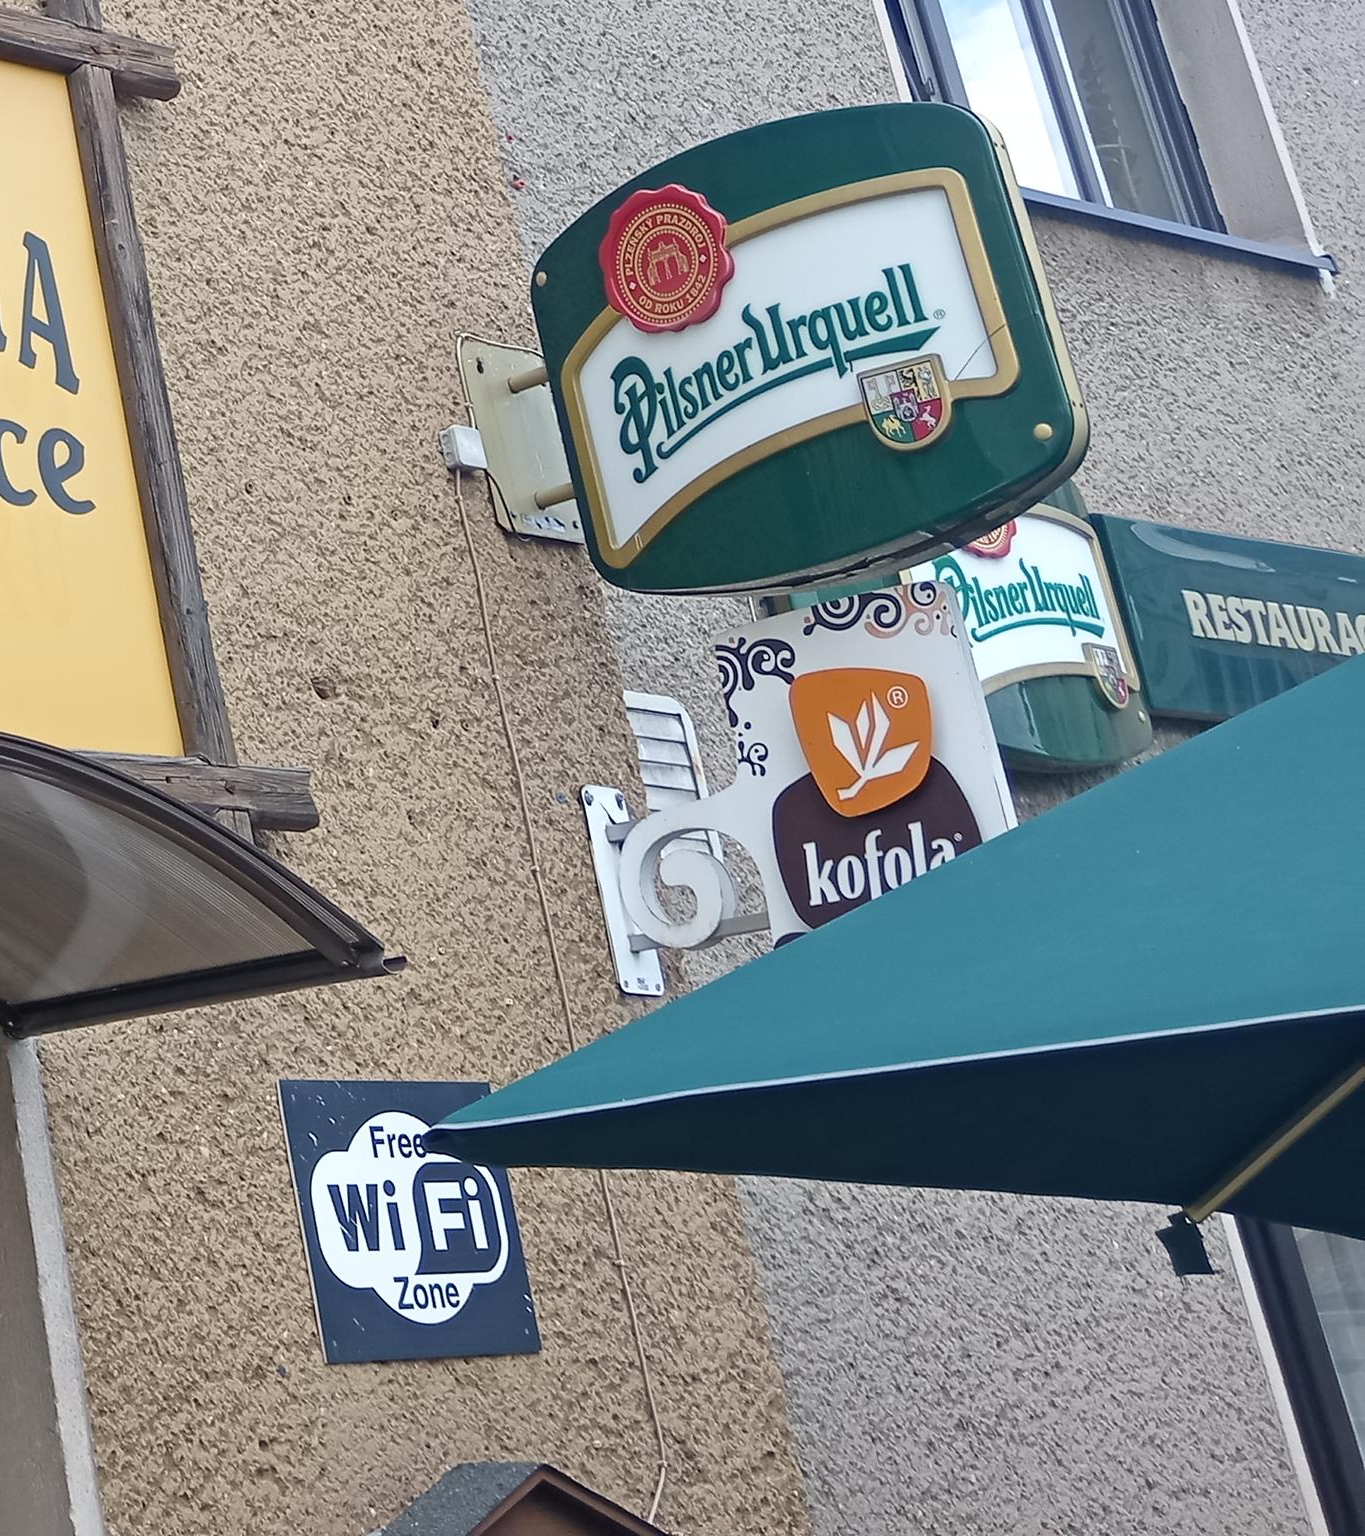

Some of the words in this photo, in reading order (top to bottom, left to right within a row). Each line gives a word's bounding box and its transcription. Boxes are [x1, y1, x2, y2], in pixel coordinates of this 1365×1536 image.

[657, 214, 707, 248] PRAZDROJ
[639, 295, 653, 310] OD
[655, 299, 685, 313] ROKU
[686, 274, 707, 303] 1842
[610, 336, 755, 484] Pilsner
[742, 263, 929, 379] Urquell
[1019, 558, 1101, 636] Urquell
[393, 1276, 461, 1310] Zone
